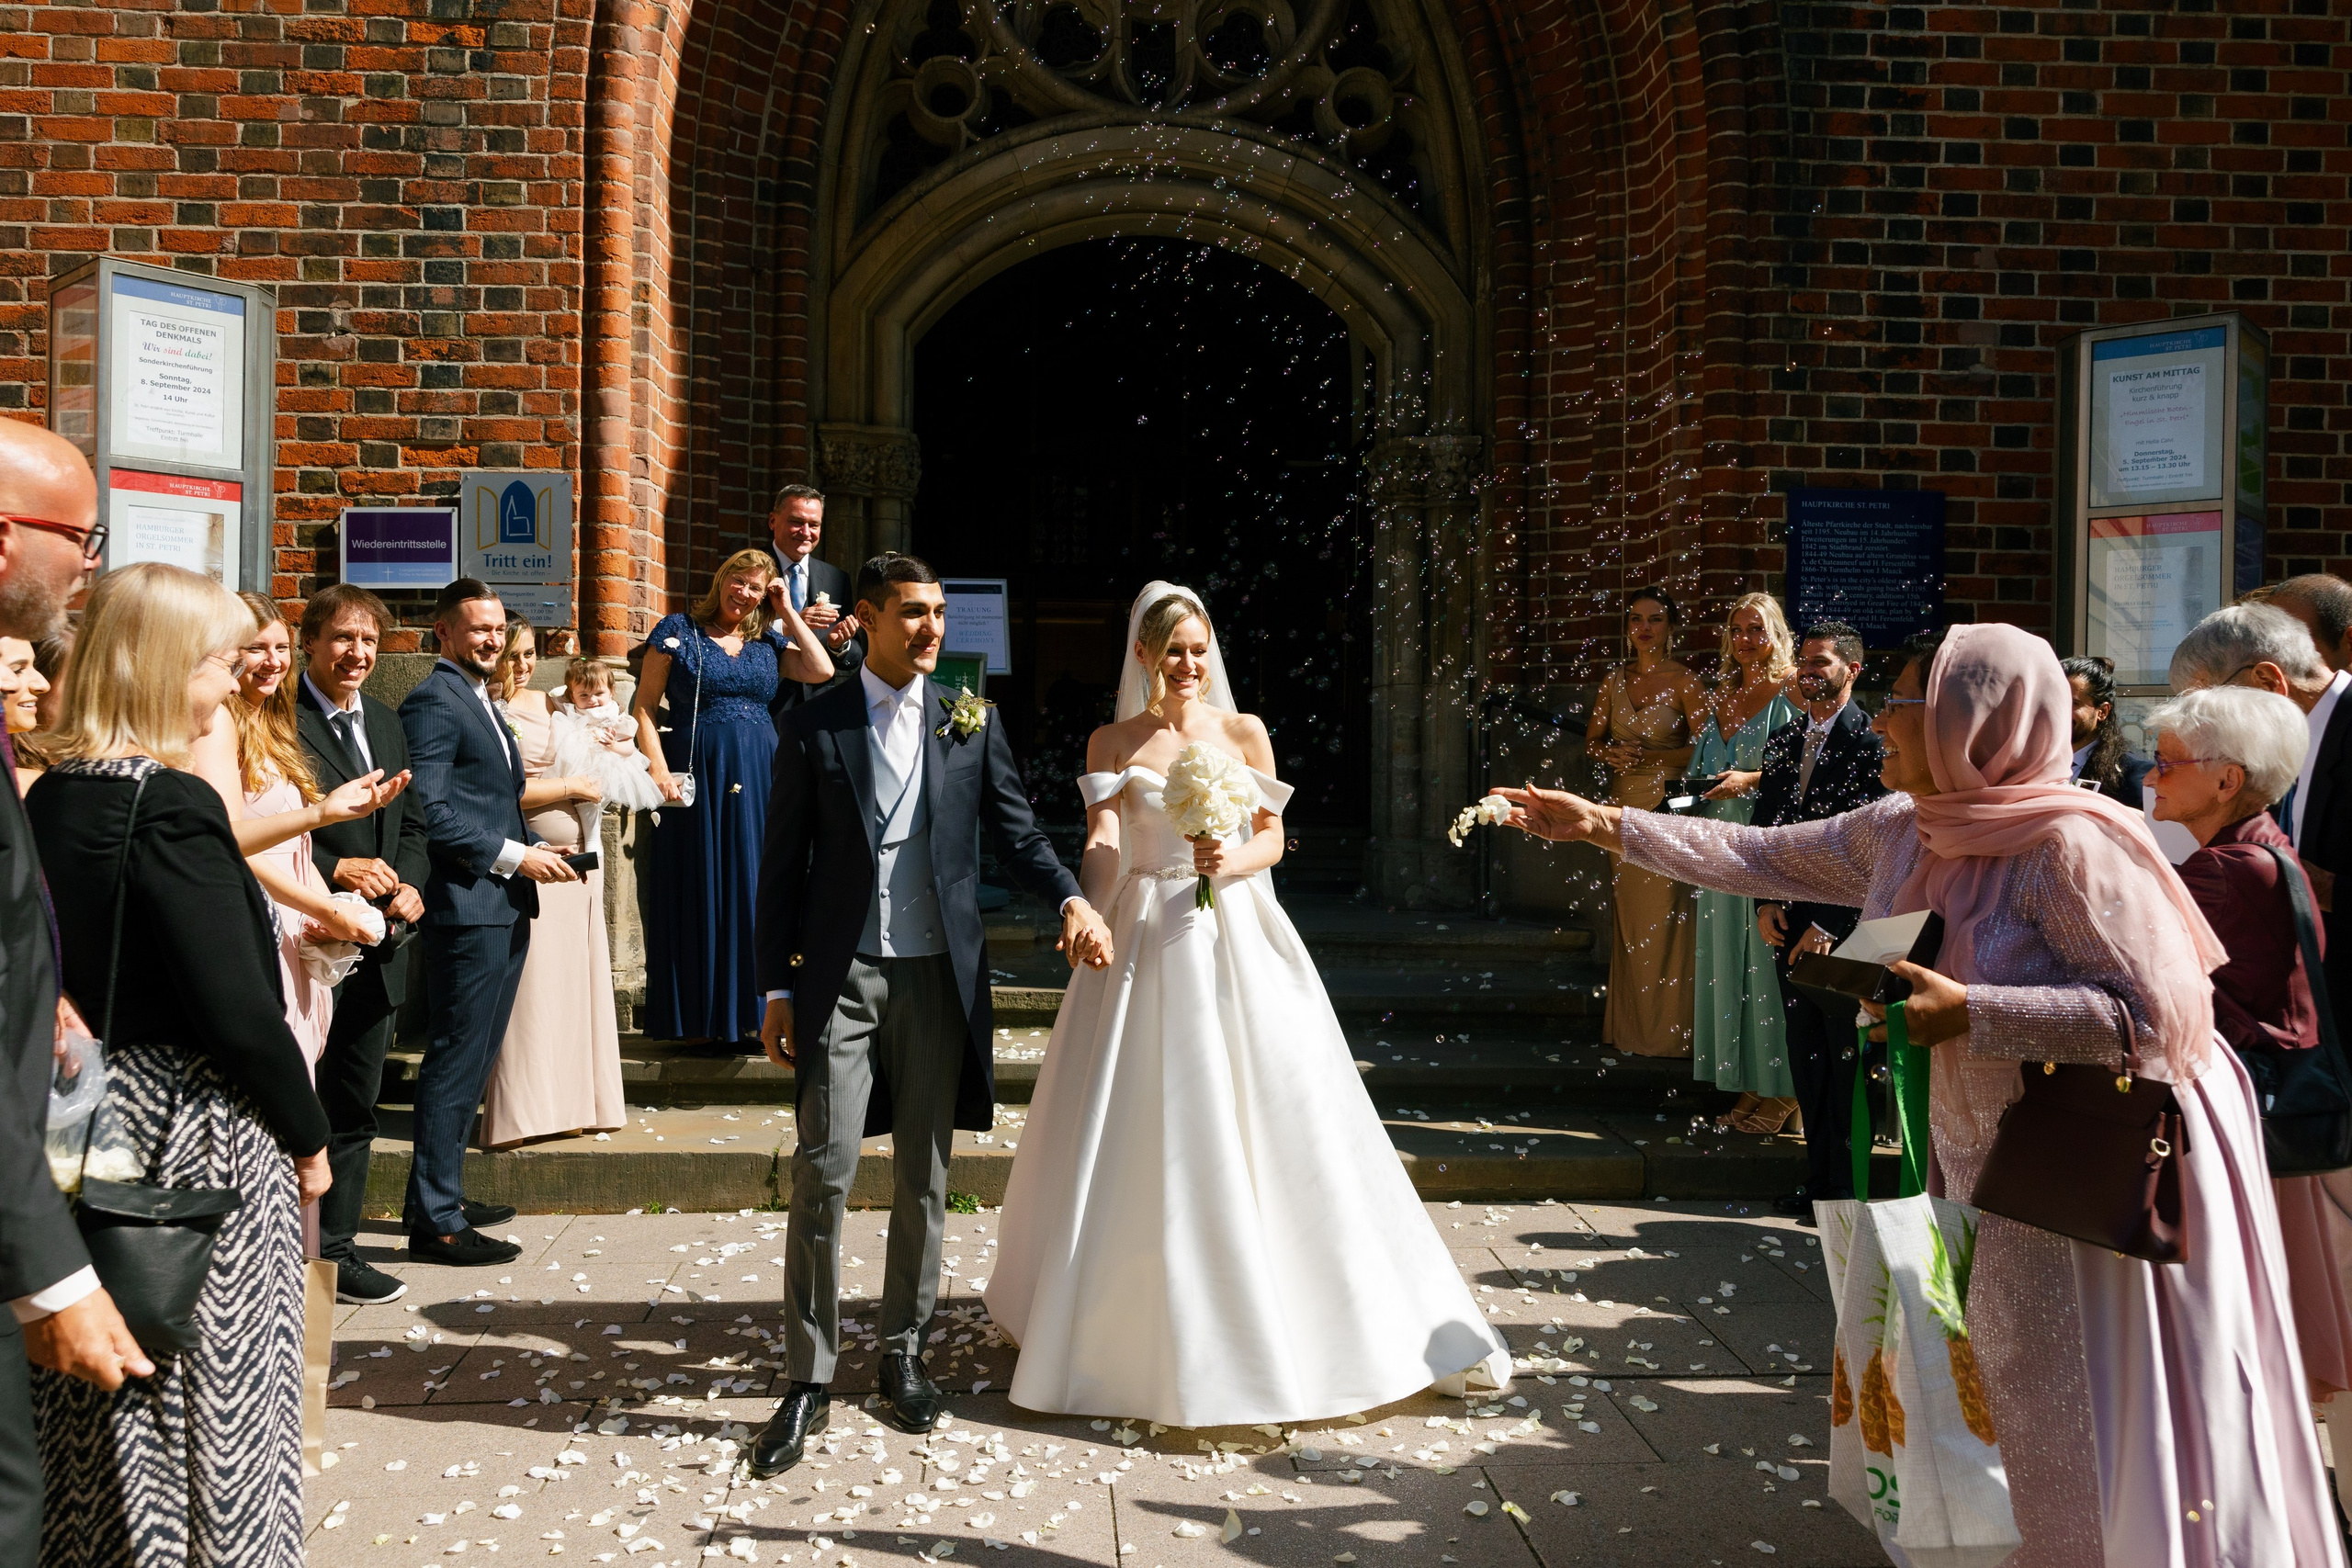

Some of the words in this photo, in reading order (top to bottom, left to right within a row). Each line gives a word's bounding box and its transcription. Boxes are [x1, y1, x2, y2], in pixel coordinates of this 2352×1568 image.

[171, 292, 211, 303] HAUPTKIRCHE
[141, 319, 158, 328] TAG
[160, 322, 176, 331] DES
[178, 325, 217, 337] OFFENEN
[156, 331, 202, 344] DENKMALS
[2150, 339, 2191, 348] HAUPTKIRCHE
[142, 341, 161, 352] Wir
[163, 347, 183, 356] sind
[185, 349, 213, 361] dabei!
[139, 356, 213, 374] Sonderkirchenführung
[159, 373, 192, 385] Sonntag,
[2113, 374, 2143, 383] KUNST
[2146, 371, 2160, 379] AM
[2163, 367, 2200, 377] MITTAG
[150, 380, 190, 392] September
[193, 386, 211, 394] 2024
[2129, 383, 2183, 394] Kirchenführung
[175, 395, 188, 403] Uhr
[2132, 394, 2147, 402] kurz
[2156, 392, 2179, 400] knapp
[146, 425, 175, 435] Treffpunkt:
[177, 430, 203, 438] Turmhalle
[161, 434, 178, 443] Eintritt
[2134, 449, 2175, 457] Donnerstag,
[2132, 457, 2168, 465] September
[169, 483, 210, 491] HAUPTKIRCHE
[1802, 501, 1855, 509] HAUPTKIRCHE
[1869, 502, 1890, 510] PETRI
[136, 523, 185, 534] HAMBURGER
[1801, 519, 1824, 527] Älteste
[1874, 522, 1893, 530] Stadt,
[136, 533, 194, 544] ORGELSOMMER
[352, 539, 447, 549] Wiedereintrittsstelle
[1802, 536, 1847, 544] Erweiterungen
[483, 553, 517, 568] Tritt
[523, 554, 551, 568] ein!
[2114, 565, 2163, 573] HAMBURGER
[2114, 573, 2172, 581] ORGELSOMMER
[1866, 585, 1884, 593] going
